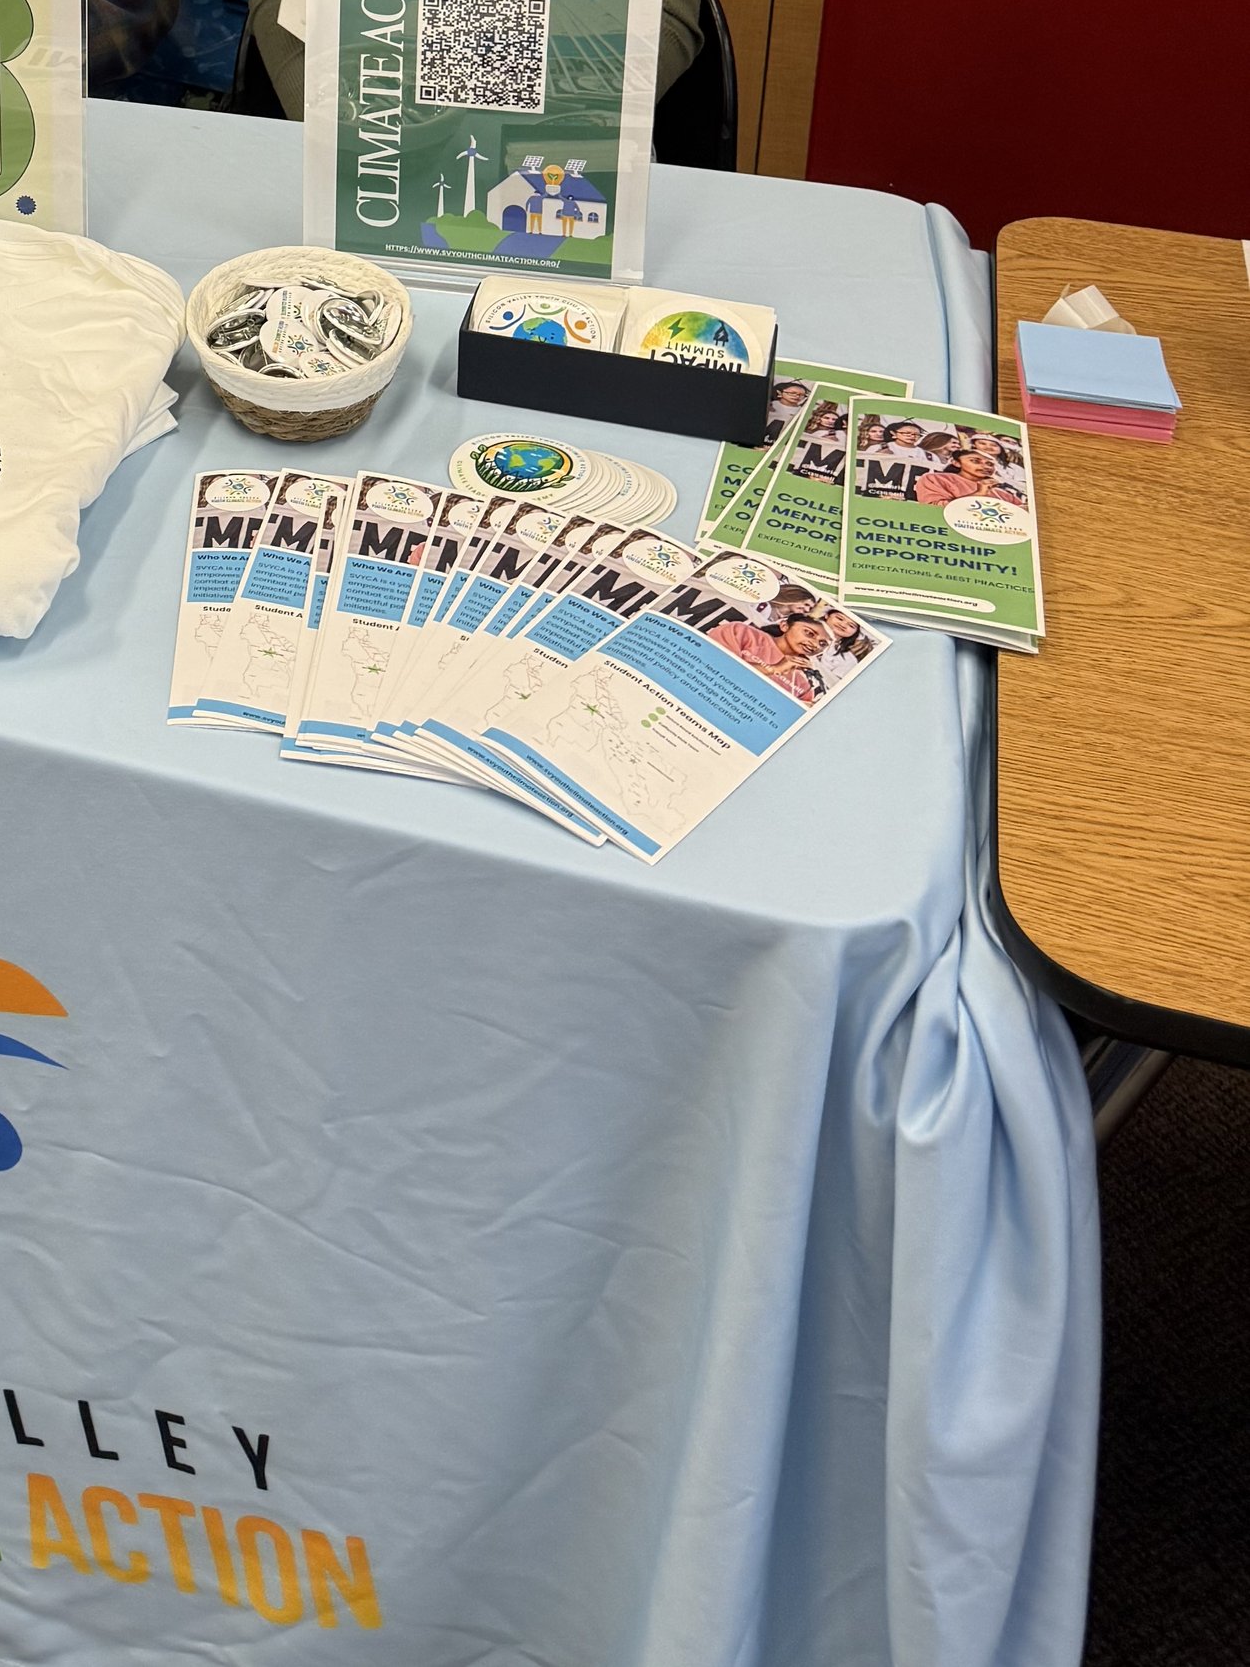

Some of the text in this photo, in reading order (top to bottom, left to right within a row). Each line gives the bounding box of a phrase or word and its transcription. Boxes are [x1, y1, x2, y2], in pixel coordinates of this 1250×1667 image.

[355, 53, 403, 227] CLIMATE
[665, 342, 724, 358] SUMMIT
[758, 534, 833, 558] EXPECTATIONS
[856, 517, 949, 536] COLLEGE
[856, 531, 996, 557] MENTORSHIP
[852, 563, 932, 577] EXPECTATIONS
[946, 575, 972, 583] BEST
[974, 579, 1035, 594] PRACTICES
[854, 546, 1018, 576] OPPORTUNITY!
[645, 617, 702, 647] Who We Are
[613, 641, 741, 724] impactful policy and education
[620, 635, 753, 722] combat climate change through
[627, 631, 778, 729] empowers teens and young adults to
[634, 625, 660, 639] SVYCA
[678, 646, 720, 675] youth-led
[719, 675, 758, 703] nonprofit
[758, 702, 777, 716] that
[604, 660, 643, 684] Student
[643, 684, 674, 708] Action
[676, 706, 708, 732] Teams
[708, 731, 731, 749] Map
[27, 1473, 382, 1631] ACTION
